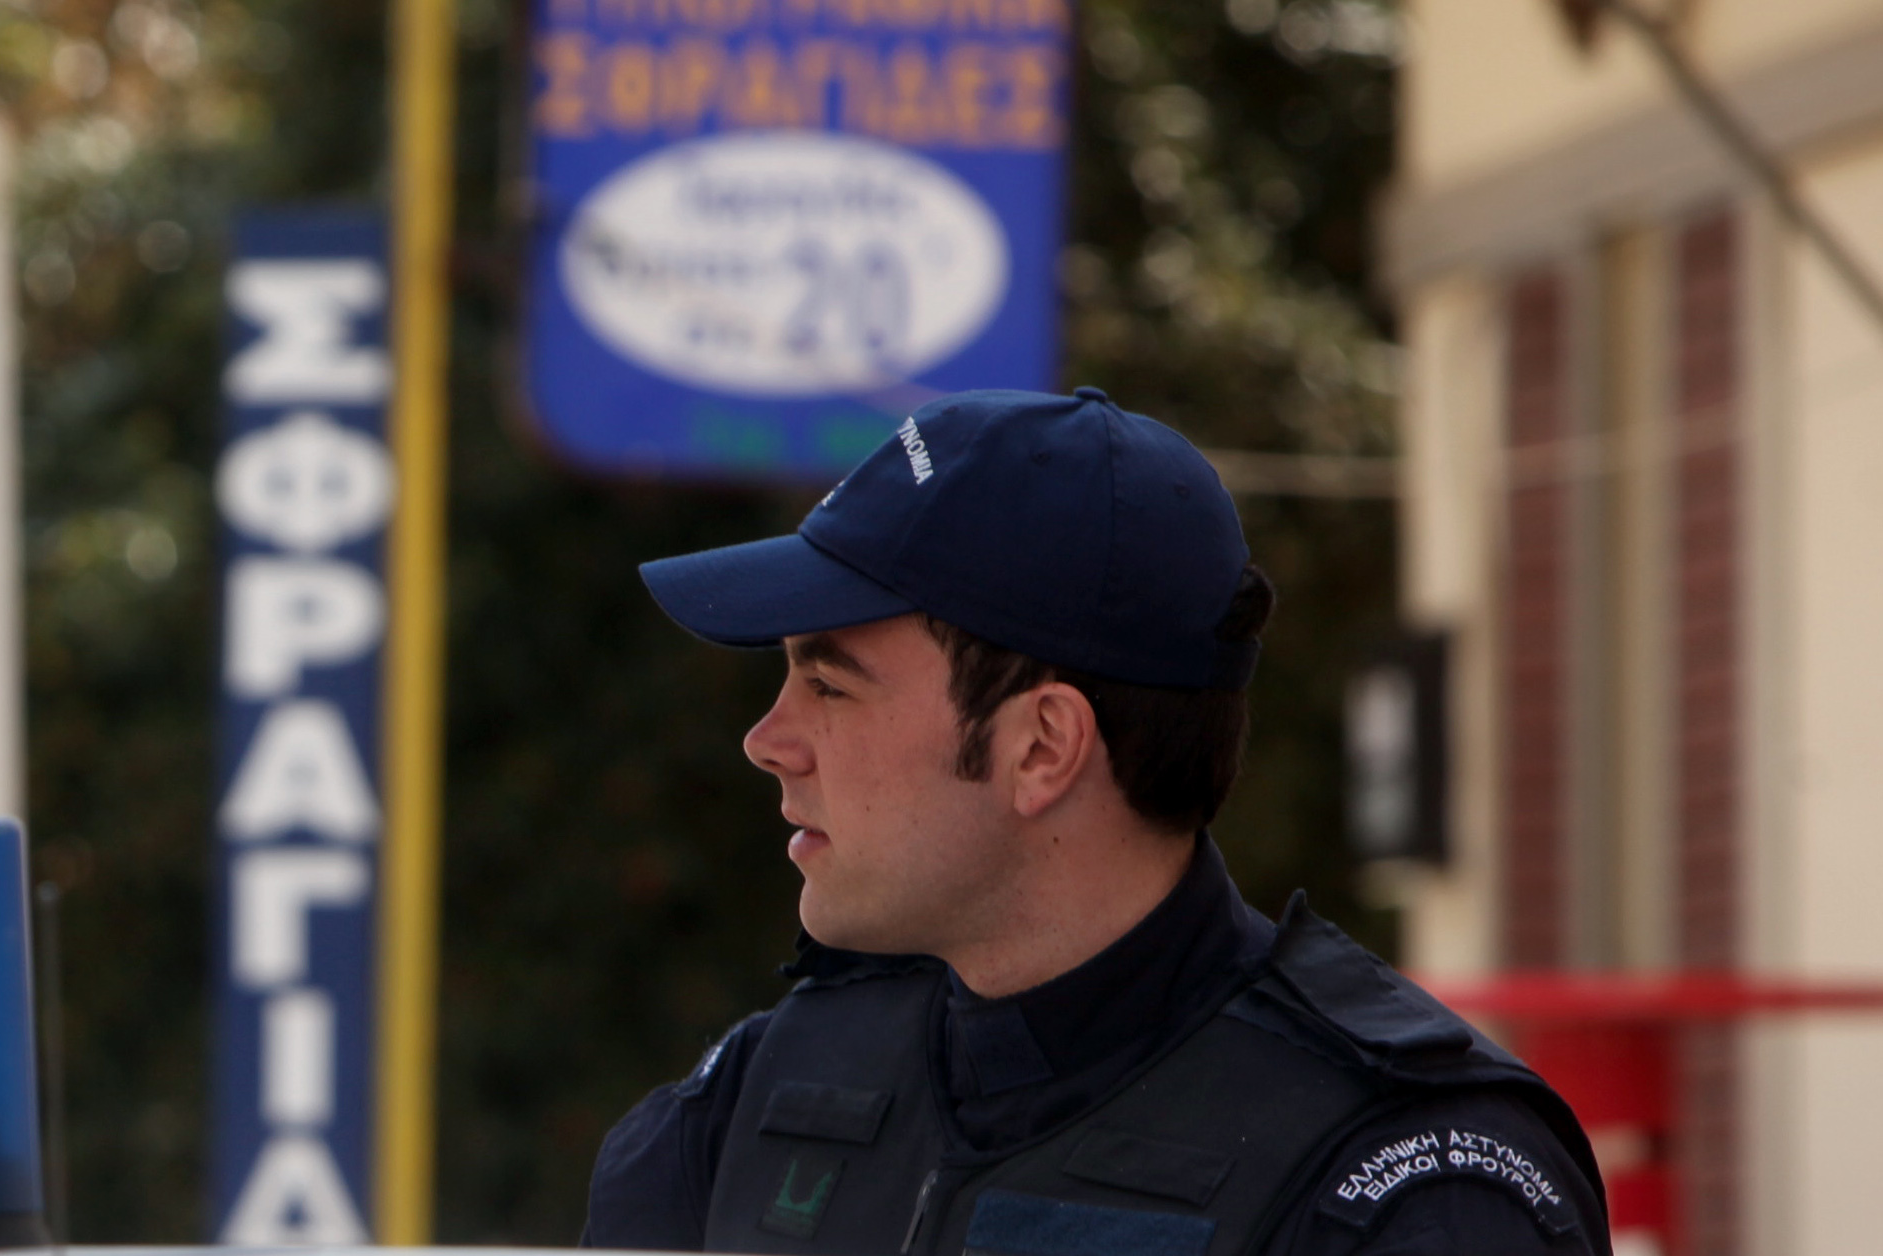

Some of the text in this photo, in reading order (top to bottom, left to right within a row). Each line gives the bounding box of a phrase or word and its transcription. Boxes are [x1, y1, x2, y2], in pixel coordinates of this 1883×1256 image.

[1336, 1128, 1563, 1207] ΕΛΛΗΝΙΚΗ ΑΣΤΥΝΟΜΙΑ
[1363, 1149, 1541, 1207] ΕΙΔΙΚΟΙ ΦΡΟΥΡΟΙ
